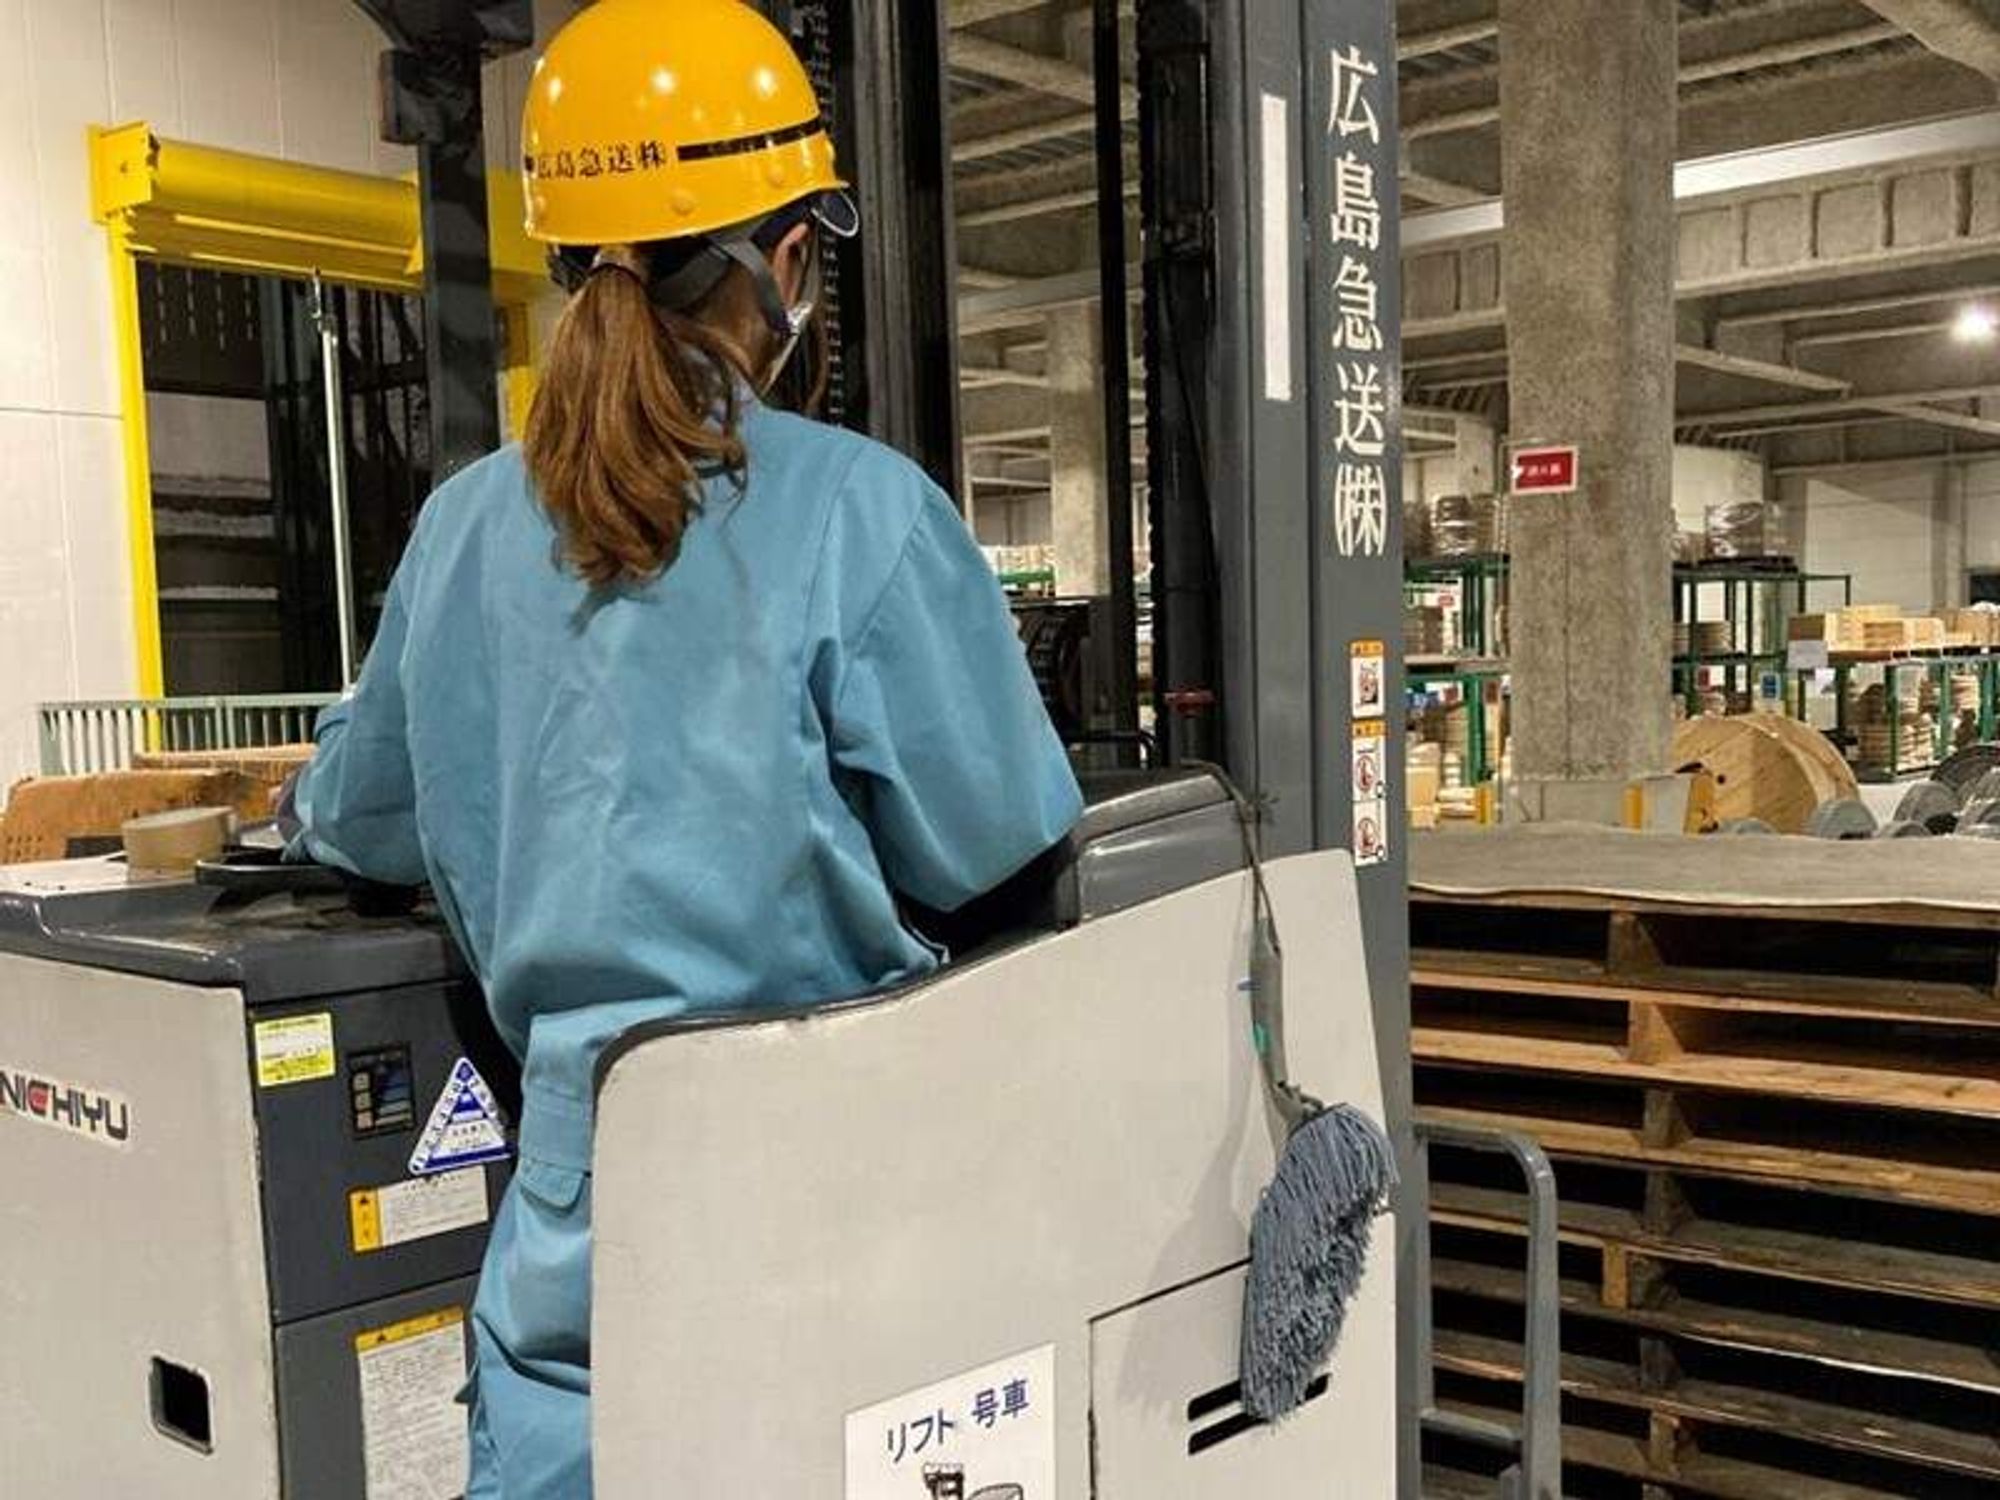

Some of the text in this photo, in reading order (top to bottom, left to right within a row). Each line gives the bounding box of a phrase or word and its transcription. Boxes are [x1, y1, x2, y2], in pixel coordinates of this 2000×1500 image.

[0, 1070, 128, 1140] NICHIYU
[887, 1378, 1029, 1463] リフト 号車
